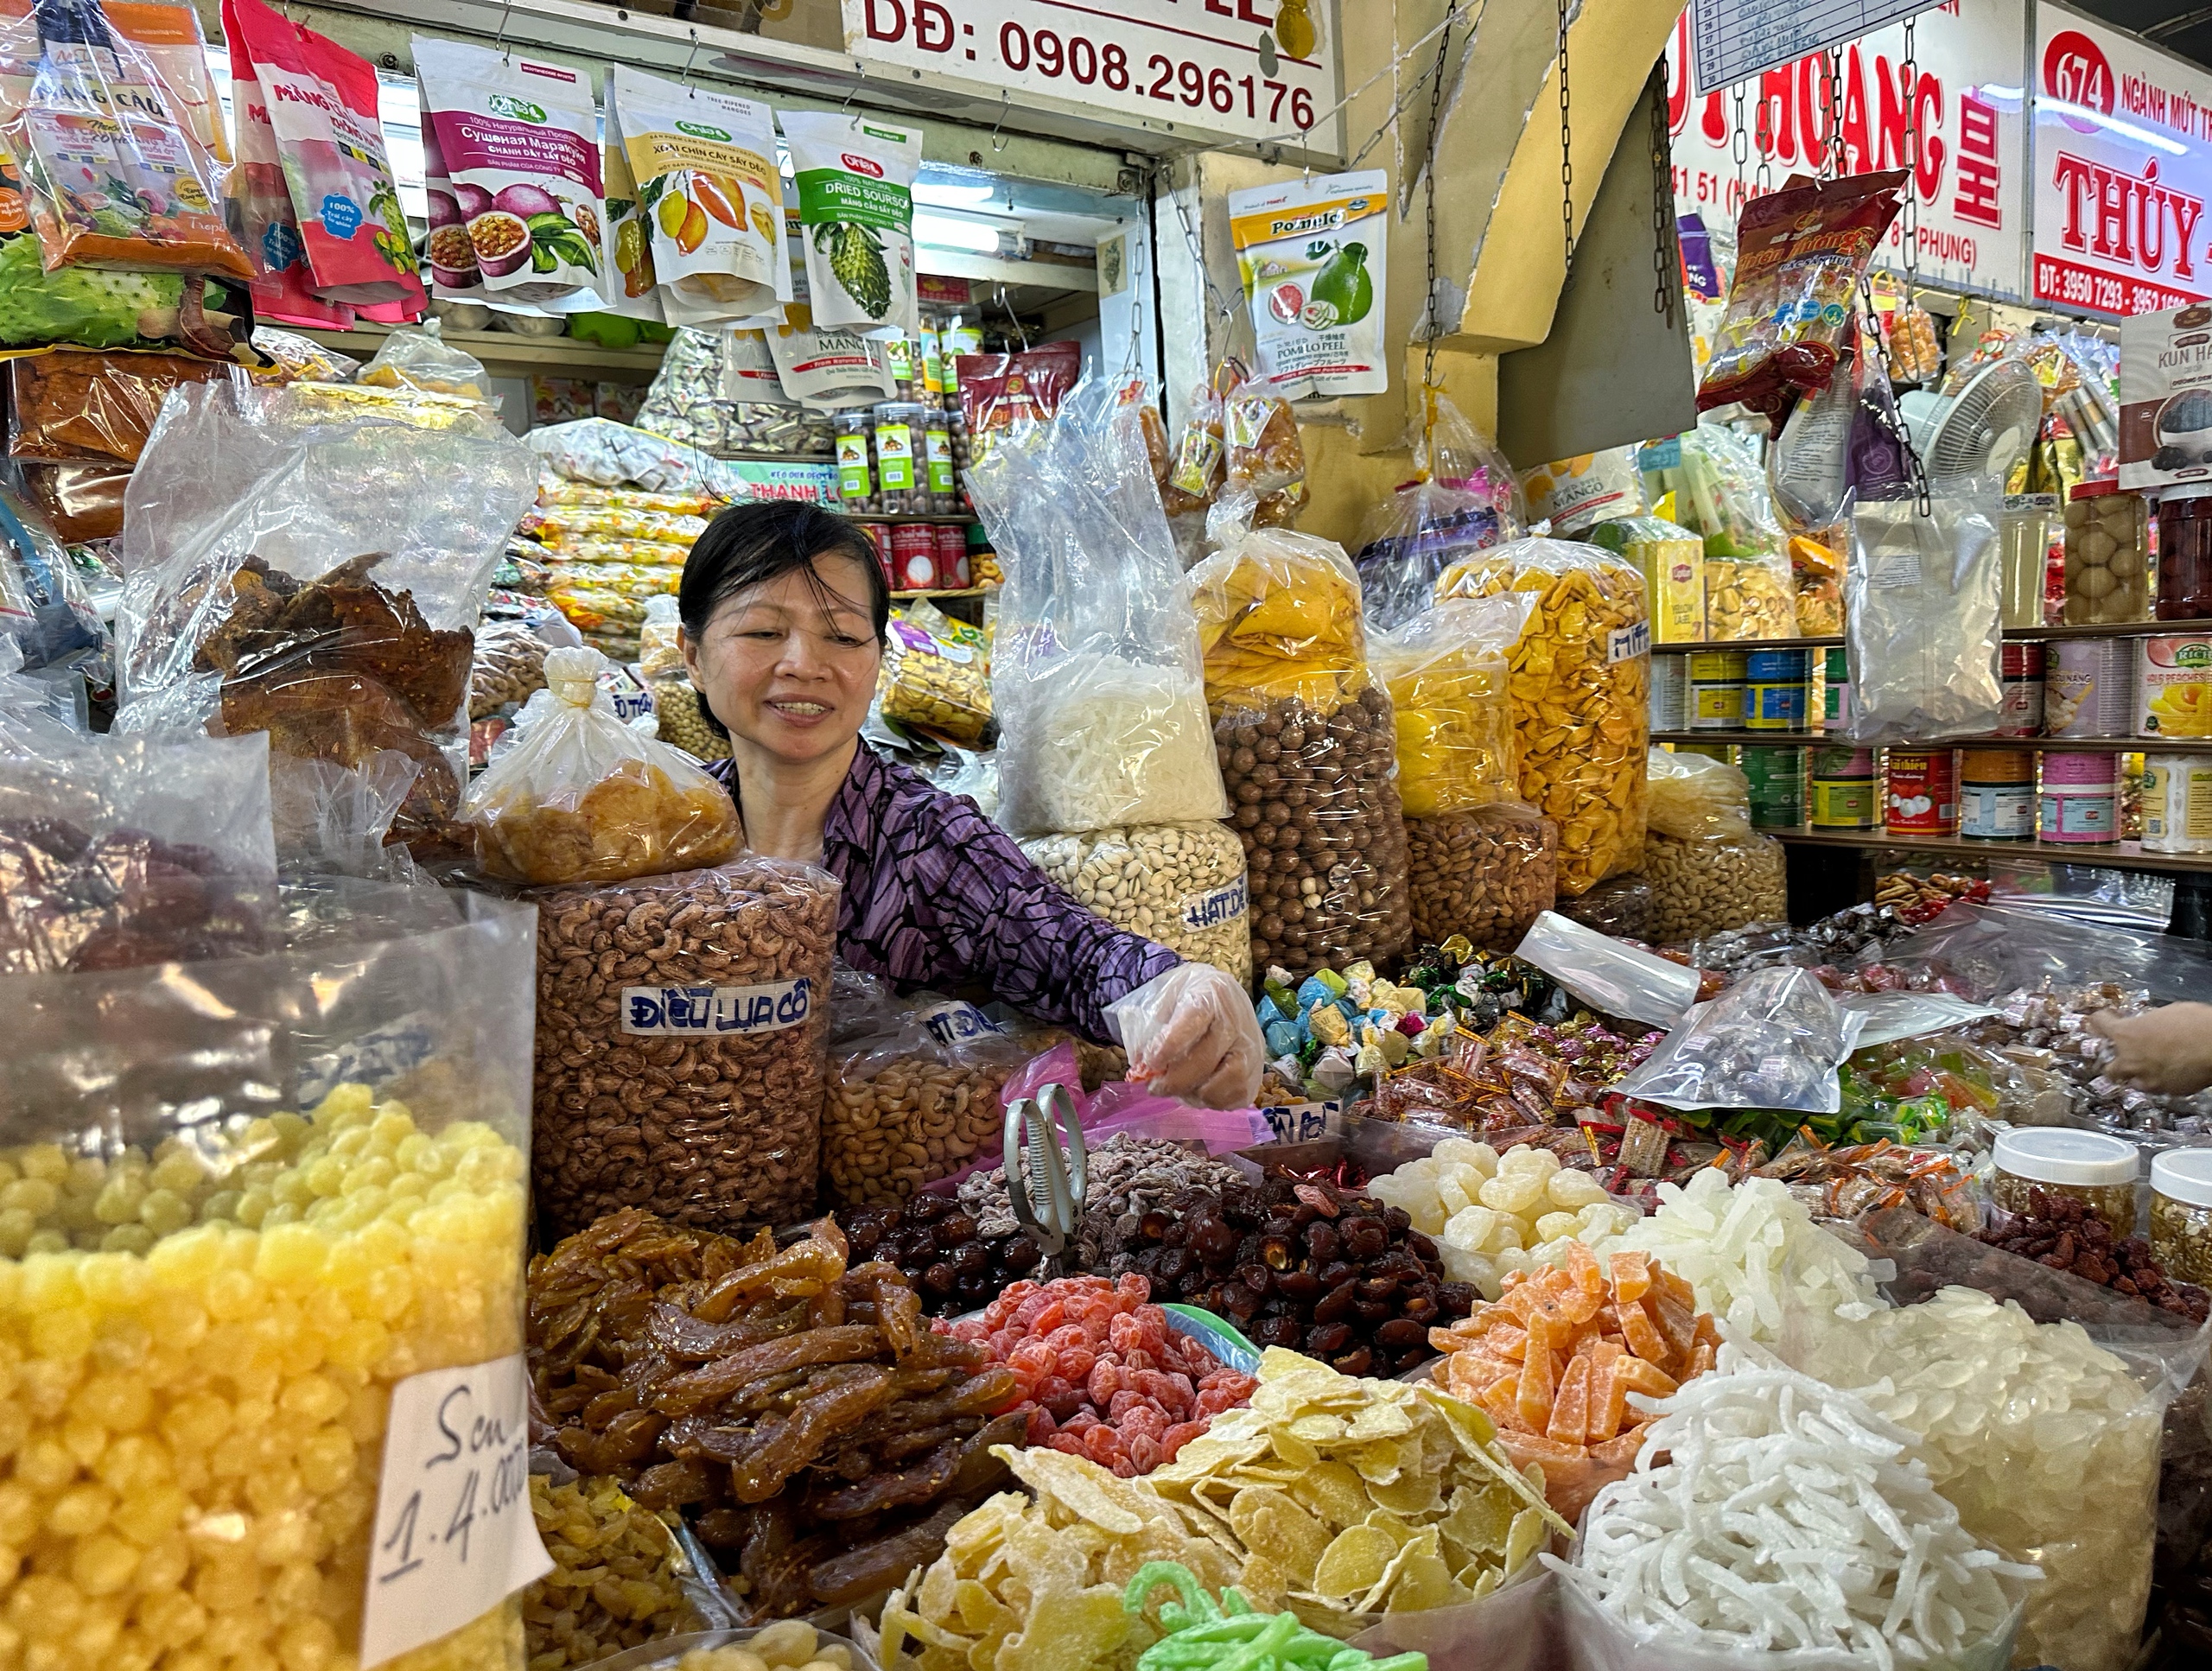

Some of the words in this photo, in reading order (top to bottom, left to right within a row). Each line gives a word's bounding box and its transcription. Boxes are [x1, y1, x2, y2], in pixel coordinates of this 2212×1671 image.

[1000, 21, 1314, 130] 0908.296176
[2055, 52, 2104, 111] 674
[2120, 71, 2166, 124] NGÀNH
[825, 182, 861, 197] DRIED
[329, 202, 355, 214] 100%
[2052, 150, 2204, 282] THÚY
[2062, 269, 2093, 304] 3950
[2094, 276, 2123, 311] 7293
[820, 339, 874, 352] MANGO
[1322, 341, 1344, 351] PEEL
[2158, 348, 2190, 369] KUN
[749, 483, 818, 500] THANH
[1553, 481, 1604, 511] MANGO
